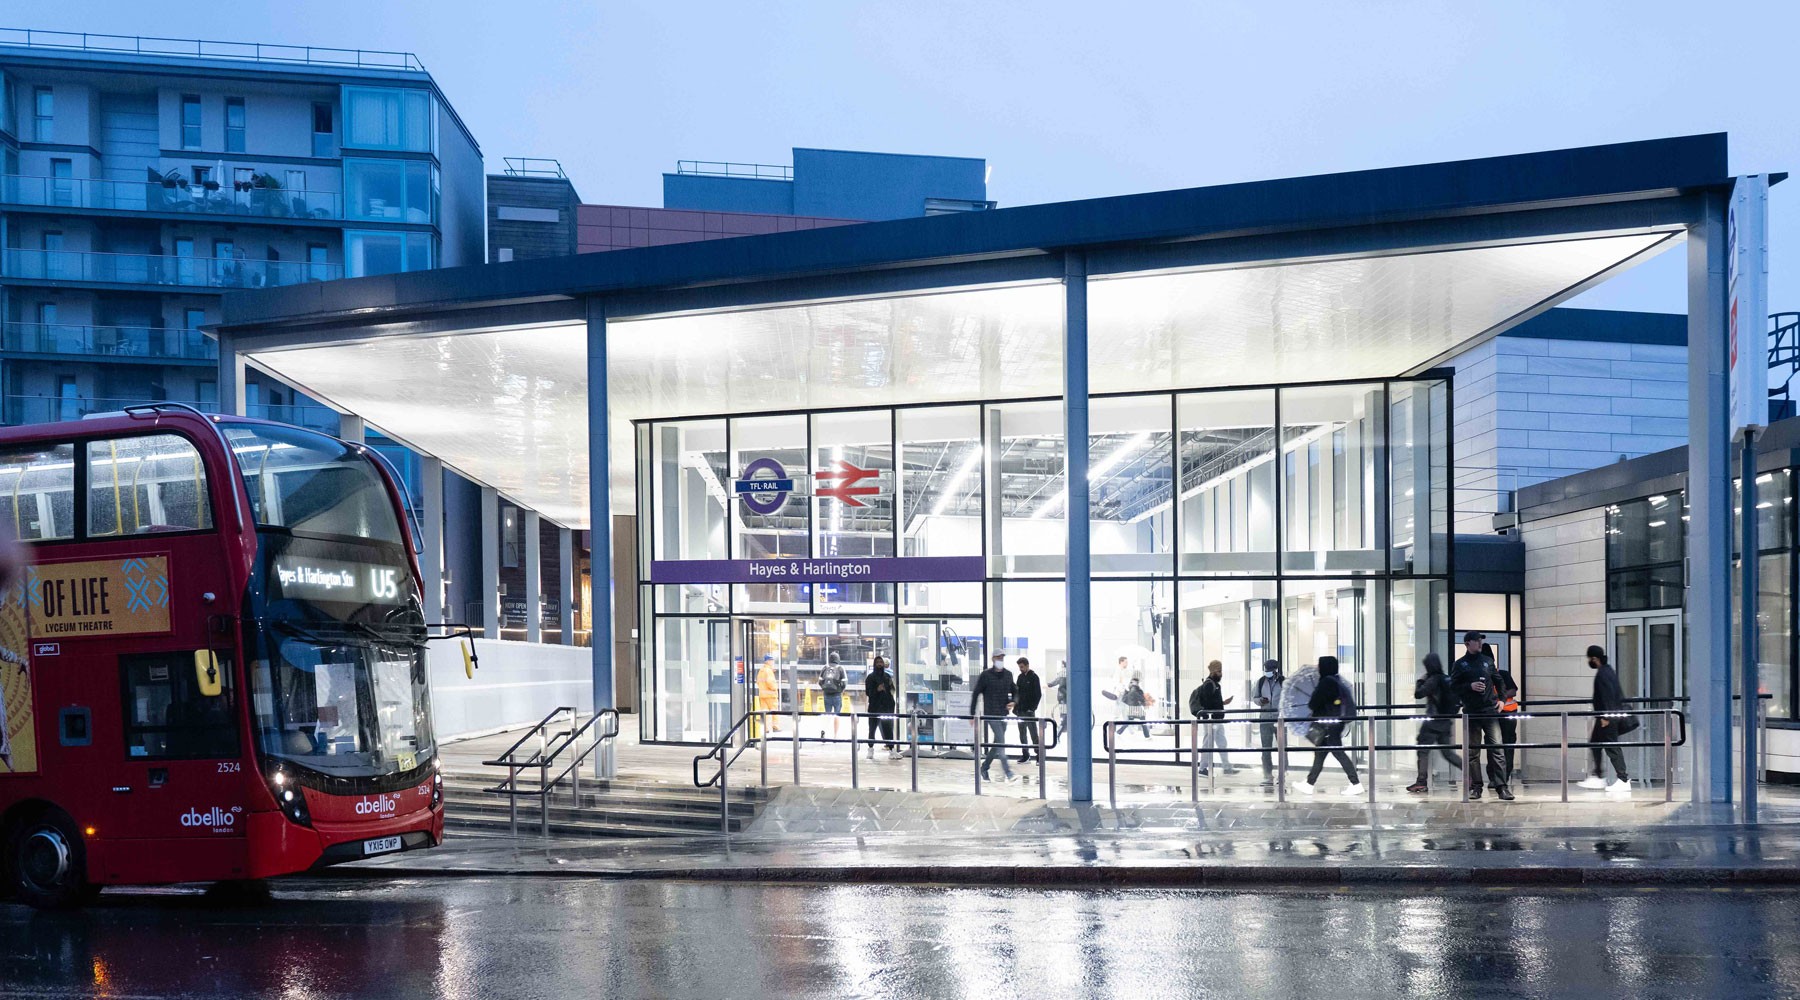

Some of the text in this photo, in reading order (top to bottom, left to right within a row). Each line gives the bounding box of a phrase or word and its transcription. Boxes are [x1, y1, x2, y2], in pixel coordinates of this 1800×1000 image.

[297, 566, 305, 584] &
[305, 567, 341, 589] Harlington
[749, 562, 871, 578] Hayes & Harlington
[371, 568, 397, 599] U5
[43, 577, 111, 617] OF LIFE
[45, 620, 113, 633] LYCEUM THEATRE
[39, 644, 55, 654] global
[217, 762, 240, 773] 2524
[355, 794, 396, 814] abellio
[180, 806, 235, 826] abellio
